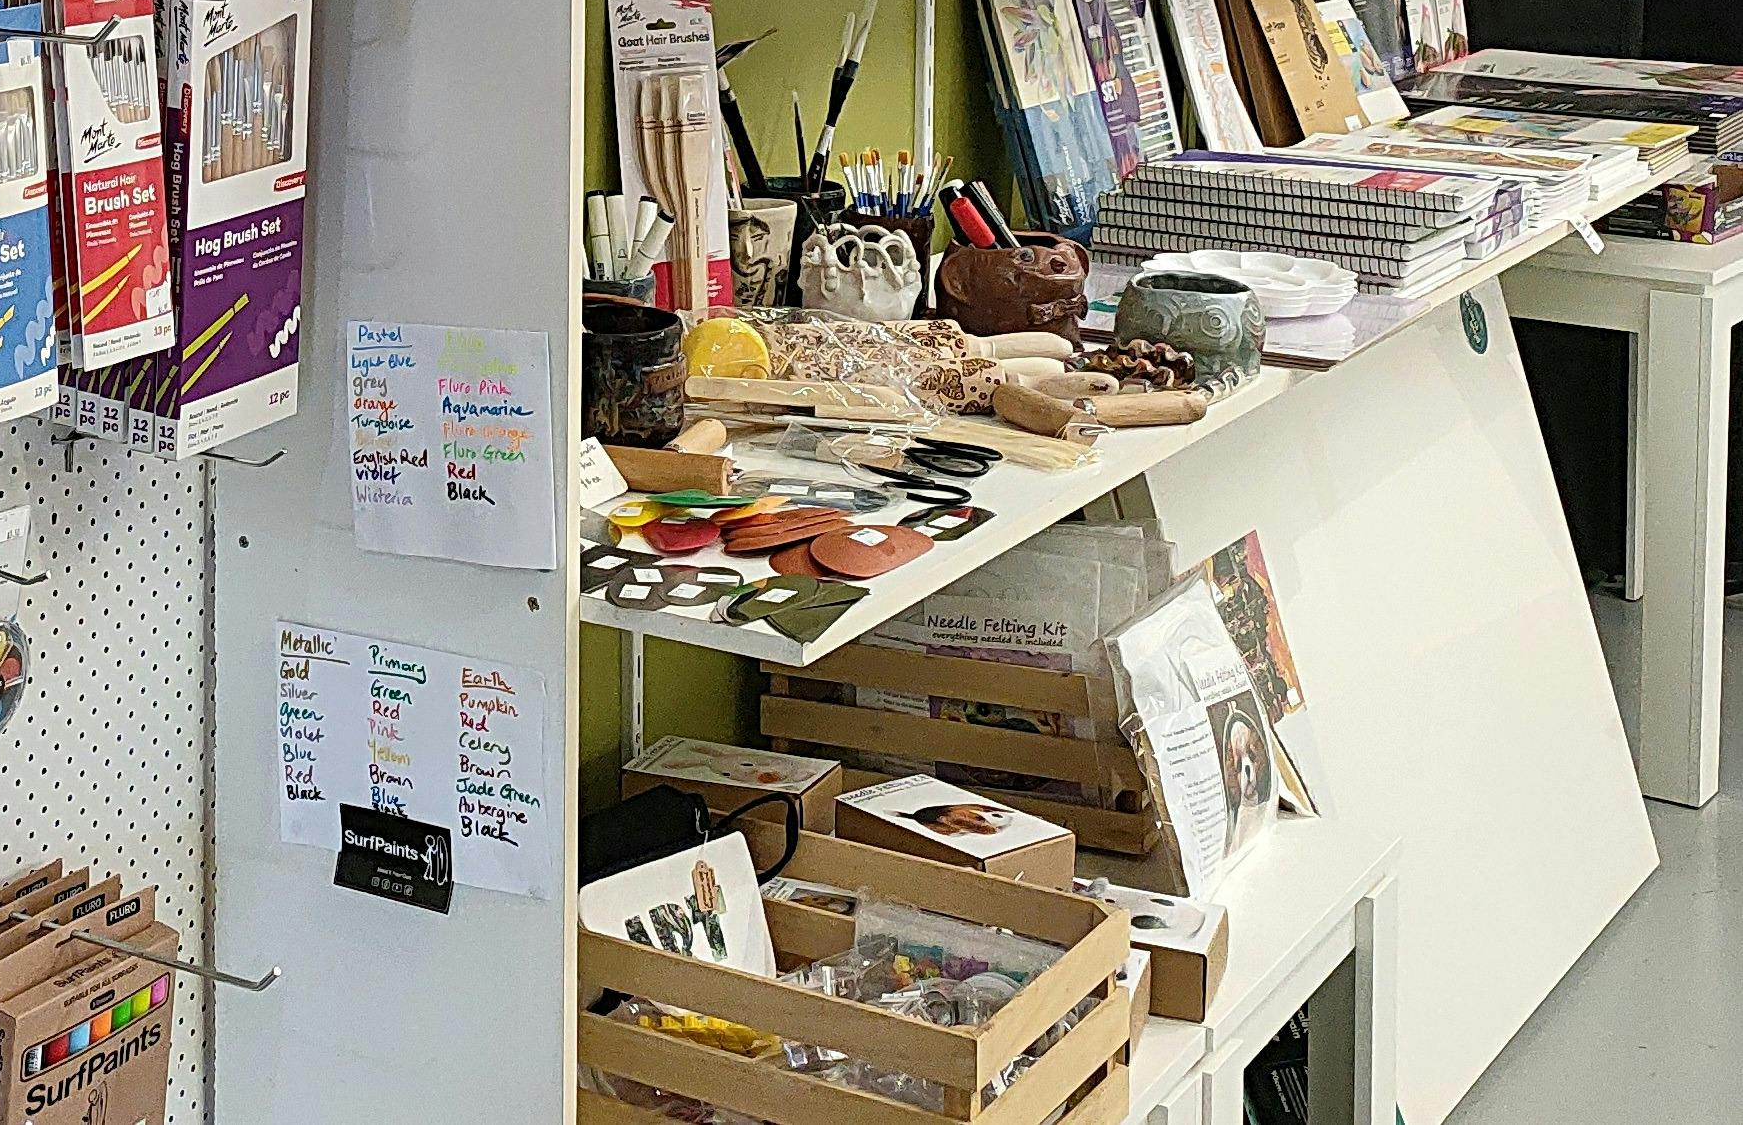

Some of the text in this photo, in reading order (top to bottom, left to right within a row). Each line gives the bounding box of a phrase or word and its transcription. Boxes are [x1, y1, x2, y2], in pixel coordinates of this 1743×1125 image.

[618, 32, 710, 47] Goat Hair Brushes
[84, 174, 137, 193] Natural Hair
[84, 186, 157, 215] Brush Set
[196, 217, 282, 256] Hog Brush Set
[359, 325, 401, 342] Pastel
[269, 389, 291, 405] 12 pc
[438, 379, 511, 395] Fluro Pink
[443, 397, 534, 421] Aquamarine
[352, 416, 414, 436] Turquoise
[353, 449, 428, 468] English Red
[444, 443, 525, 462] Fluro Green
[448, 464, 476, 480] Red
[356, 487, 412, 505] Wisteria
[447, 483, 495, 505] Black
[928, 615, 1067, 638] Needle Felting Kit
[280, 630, 336, 654] Metallic
[932, 631, 978, 643] everything
[1025, 638, 1063, 647] included
[280, 661, 309, 681] Gold
[462, 668, 512, 690] Earth
[280, 684, 317, 700] Silver
[371, 680, 412, 704] Green
[373, 701, 400, 720] Red
[460, 693, 518, 717] Pumpkin
[368, 718, 403, 741] Pink
[460, 713, 488, 732] Red
[283, 744, 316, 762] Blue
[460, 732, 511, 765] Celery
[286, 766, 314, 784] Red
[369, 764, 413, 789] Brown
[460, 754, 511, 779] Brown
[286, 785, 325, 801] Black
[371, 787, 405, 806] Blue
[457, 779, 540, 808] Jade Green
[459, 797, 527, 824] Aubergine
[461, 816, 518, 847] Black
[345, 829, 418, 860] SurfPaints
[109, 902, 137, 922] FLURO
[25, 1022, 162, 1116] SurfPaints
